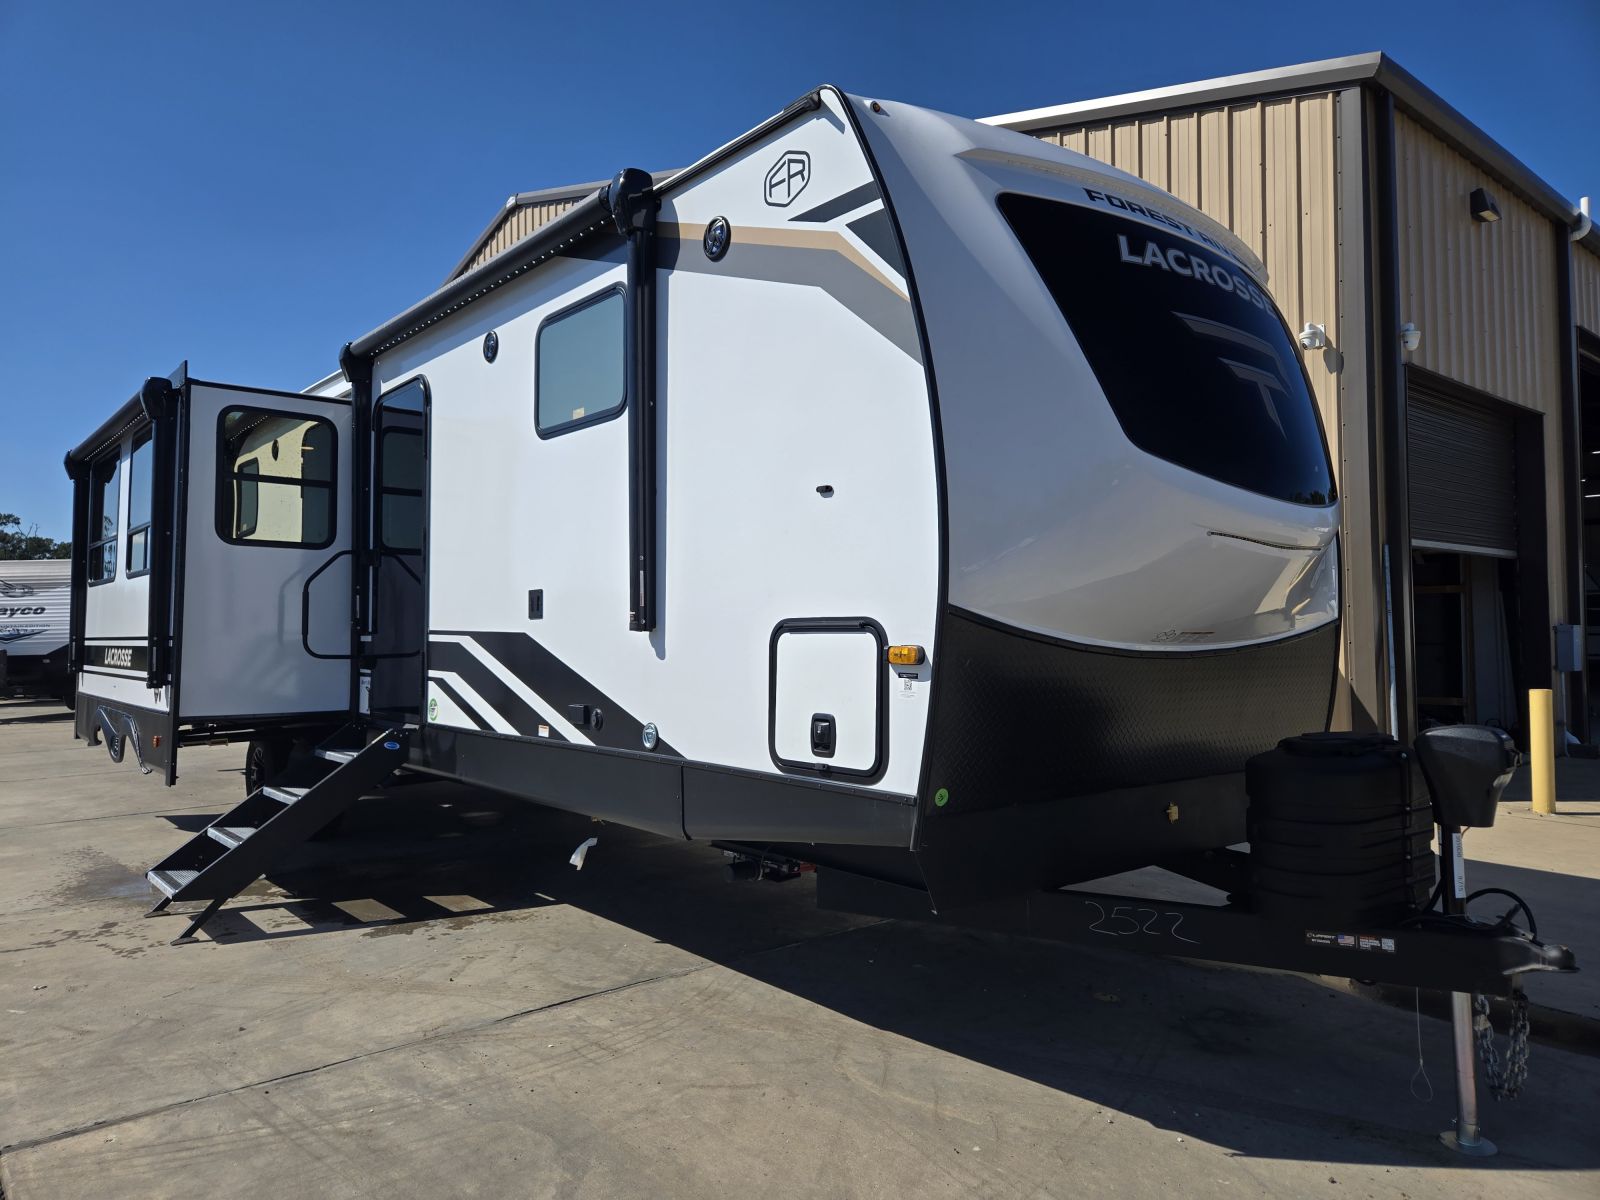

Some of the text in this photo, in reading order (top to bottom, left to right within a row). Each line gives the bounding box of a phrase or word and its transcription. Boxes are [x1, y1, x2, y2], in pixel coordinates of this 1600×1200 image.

[1082, 187, 1194, 236] FOREST
[104, 647, 133, 667] LACROSSE
[1085, 900, 1201, 944] 2522
